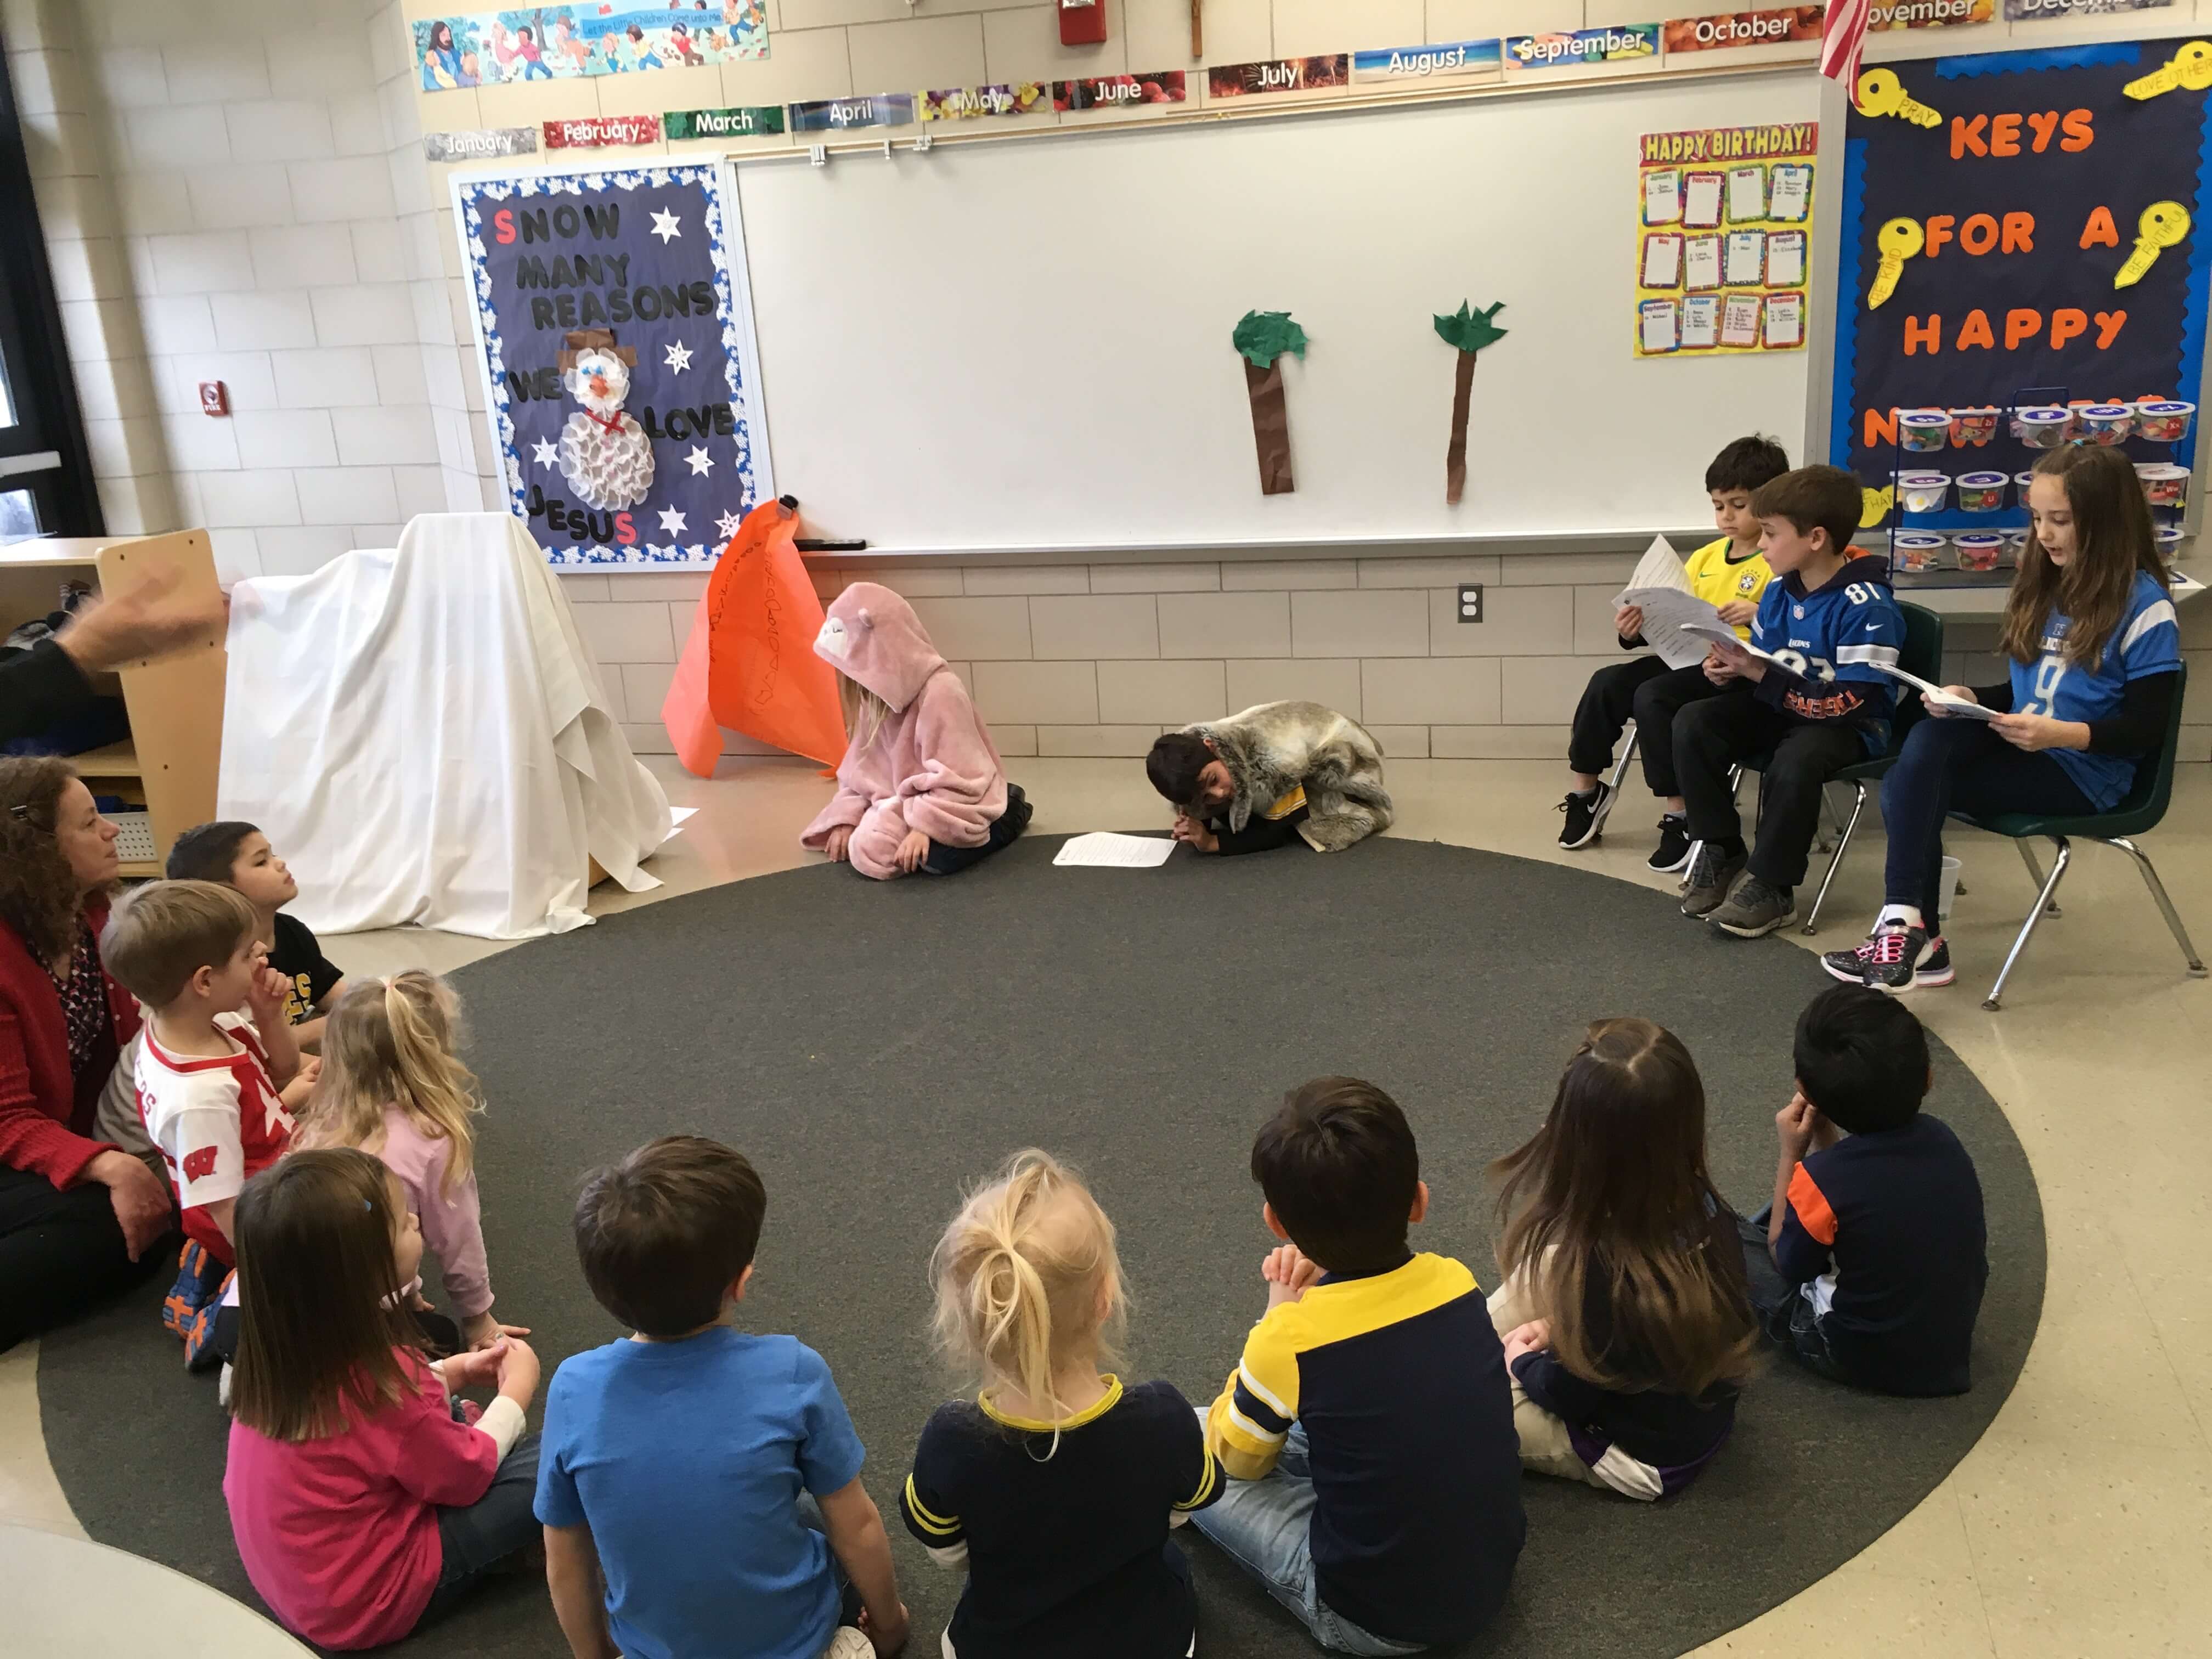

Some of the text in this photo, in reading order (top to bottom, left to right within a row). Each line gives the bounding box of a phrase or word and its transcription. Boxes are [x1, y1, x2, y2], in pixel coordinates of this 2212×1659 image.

[634, 13, 667, 26] Children
[1869, 0, 1977, 24] ovember
[1695, 14, 1792, 43] October
[1519, 30, 1646, 63] September
[1388, 46, 1465, 77] August
[1095, 80, 1142, 101] June
[1258, 65, 1298, 88] July
[2131, 74, 2164, 97] LOVE
[829, 100, 872, 126] April
[960, 88, 1004, 112] May
[1898, 98, 1935, 123] PRAY
[563, 122, 640, 143] February
[696, 112, 753, 132] March
[1950, 108, 2095, 159] KEYS
[447, 134, 513, 155] January
[1646, 126, 1811, 161] HAPPY BIRTHDAY!
[494, 203, 619, 245] SNOW
[1926, 206, 2119, 258] FOR A
[517, 253, 630, 289] MANY
[1871, 248, 1903, 302] BE KIND
[2128, 257, 2146, 275] BE
[531, 281, 713, 330] REASONS
[1904, 308, 2128, 356] HAPPY
[508, 368, 563, 402] WE
[644, 404, 735, 440] LOVE
[526, 484, 637, 545] JESUS
[1844, 582, 1881, 605] 81
[1788, 638, 1811, 649] LIONS
[2021, 655, 2067, 719] 9
